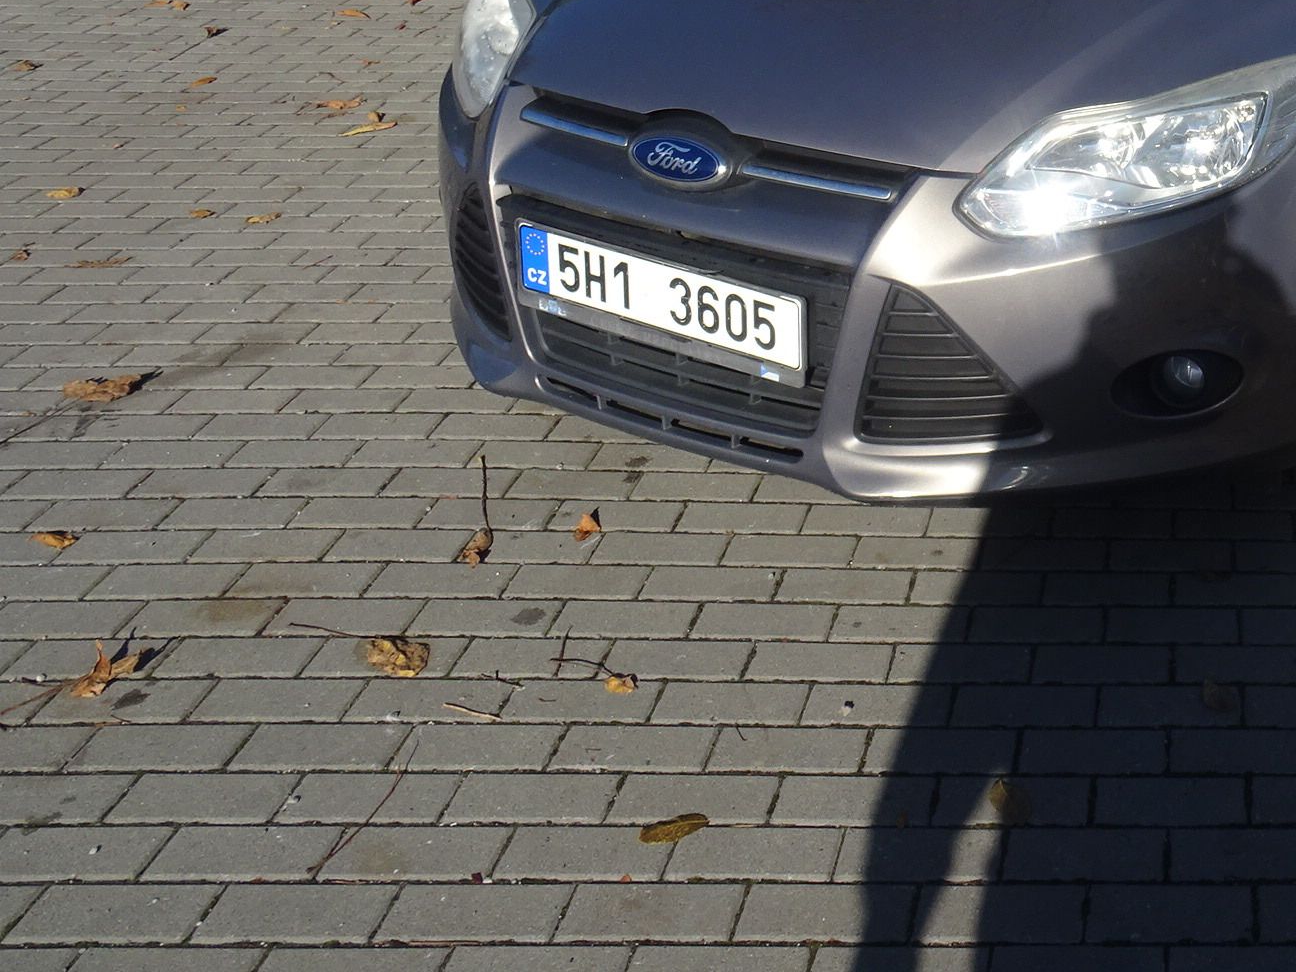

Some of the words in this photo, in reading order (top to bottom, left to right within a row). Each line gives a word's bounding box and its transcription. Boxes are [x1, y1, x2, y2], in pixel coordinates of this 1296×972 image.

[647, 141, 700, 176] Ford
[527, 267, 548, 286] CZ
[558, 243, 631, 310] 5H1
[669, 277, 776, 351] 3605
